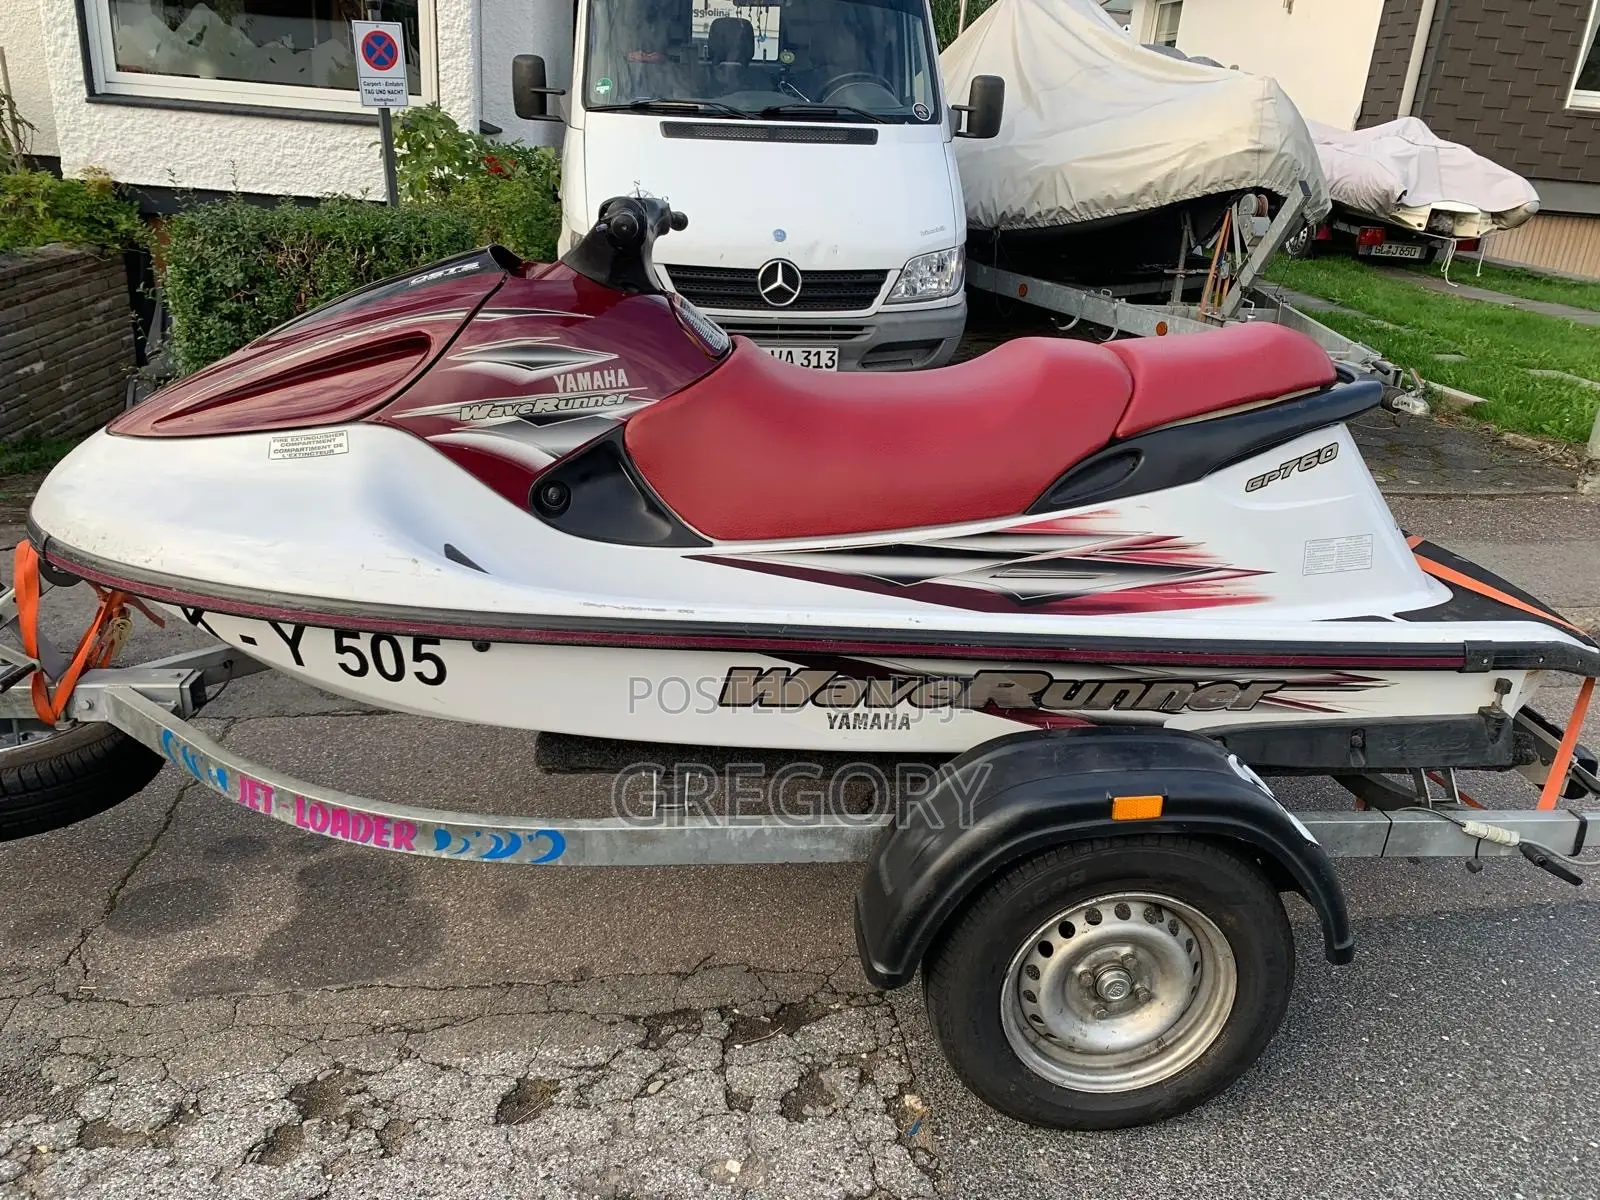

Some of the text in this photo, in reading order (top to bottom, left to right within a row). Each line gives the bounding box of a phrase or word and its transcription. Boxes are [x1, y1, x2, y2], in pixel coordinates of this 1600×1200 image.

[1400, 246, 1416, 256] 650
[800, 350, 837, 369] 313
[553, 368, 630, 393] YAMAHA
[459, 393, 631, 422] WaveRunner
[280, 437, 336, 448] COMPARTMENT
[290, 432, 345, 442] EXTINGUISHER
[273, 444, 331, 454] COMPARTIMENT
[1245, 441, 1340, 493] GP760
[333, 629, 447, 686] 505
[718, 666, 1287, 712] WaveRunner
[826, 712, 911, 730] YAMAHA
